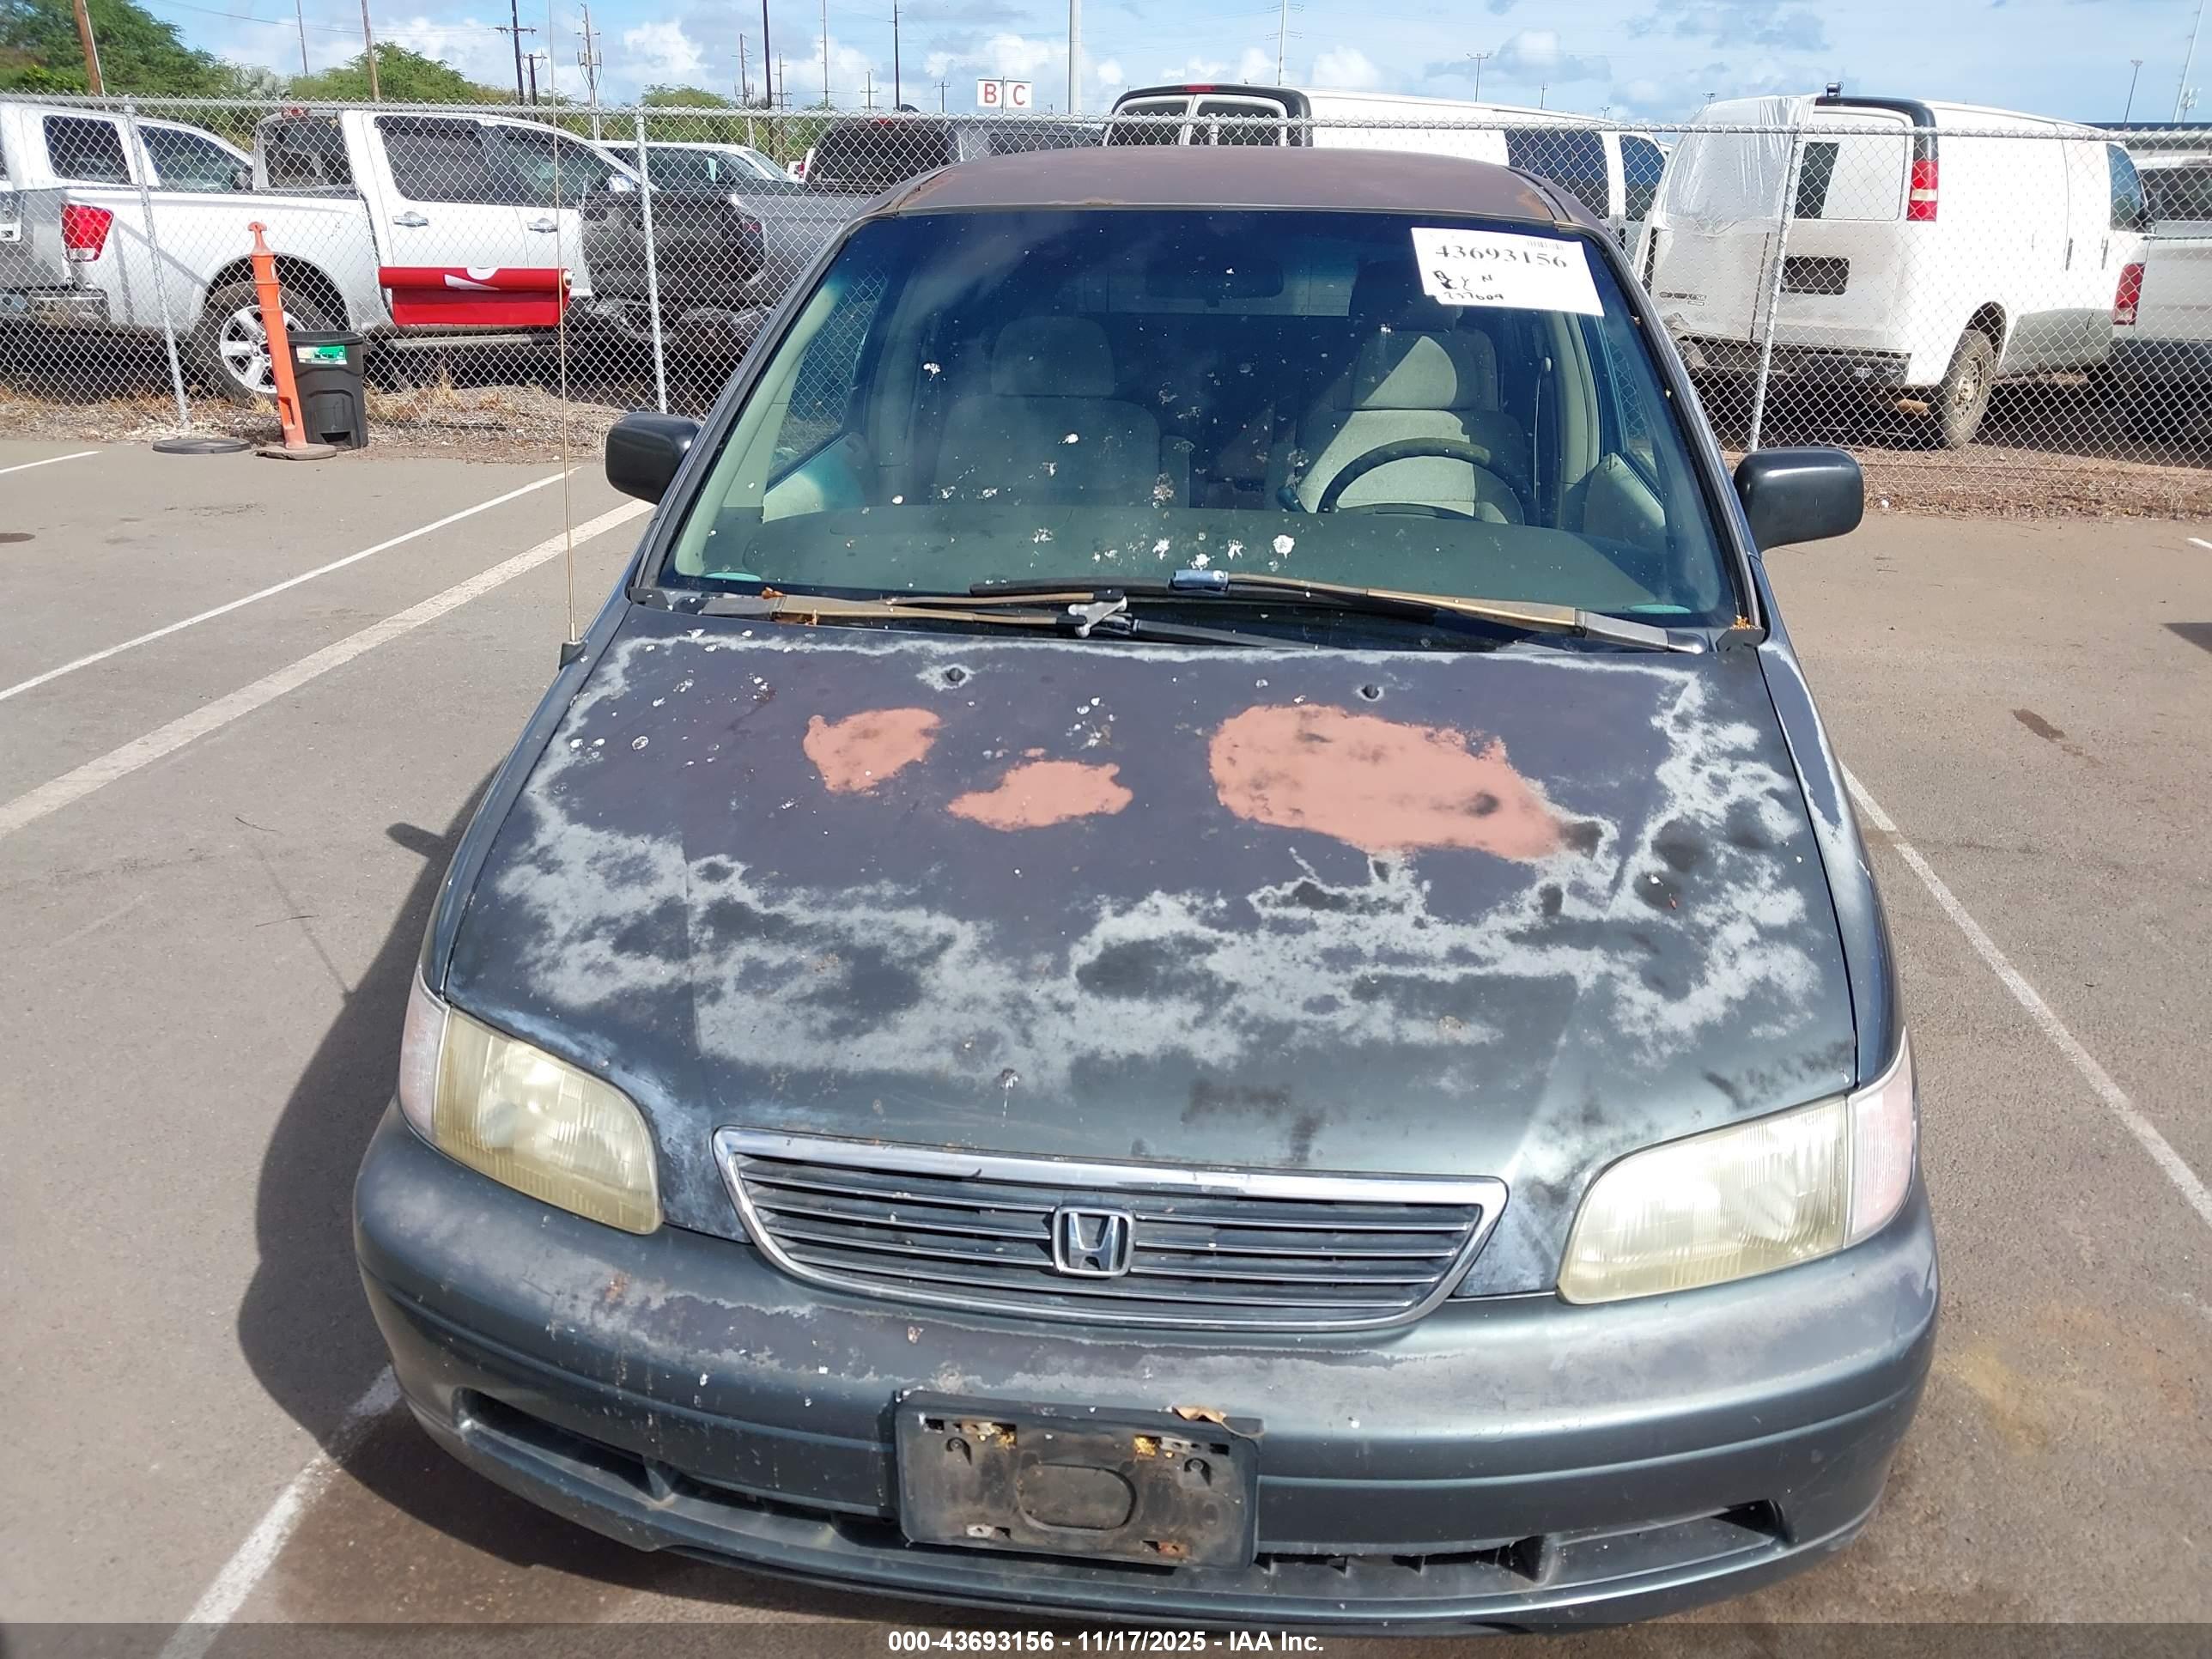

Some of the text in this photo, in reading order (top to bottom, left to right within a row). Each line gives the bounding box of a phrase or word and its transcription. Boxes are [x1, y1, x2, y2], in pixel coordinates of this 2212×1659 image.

[984, 82, 997, 104] B
[1012, 84, 1026, 106] C
[1435, 245, 1567, 268] 43693156
